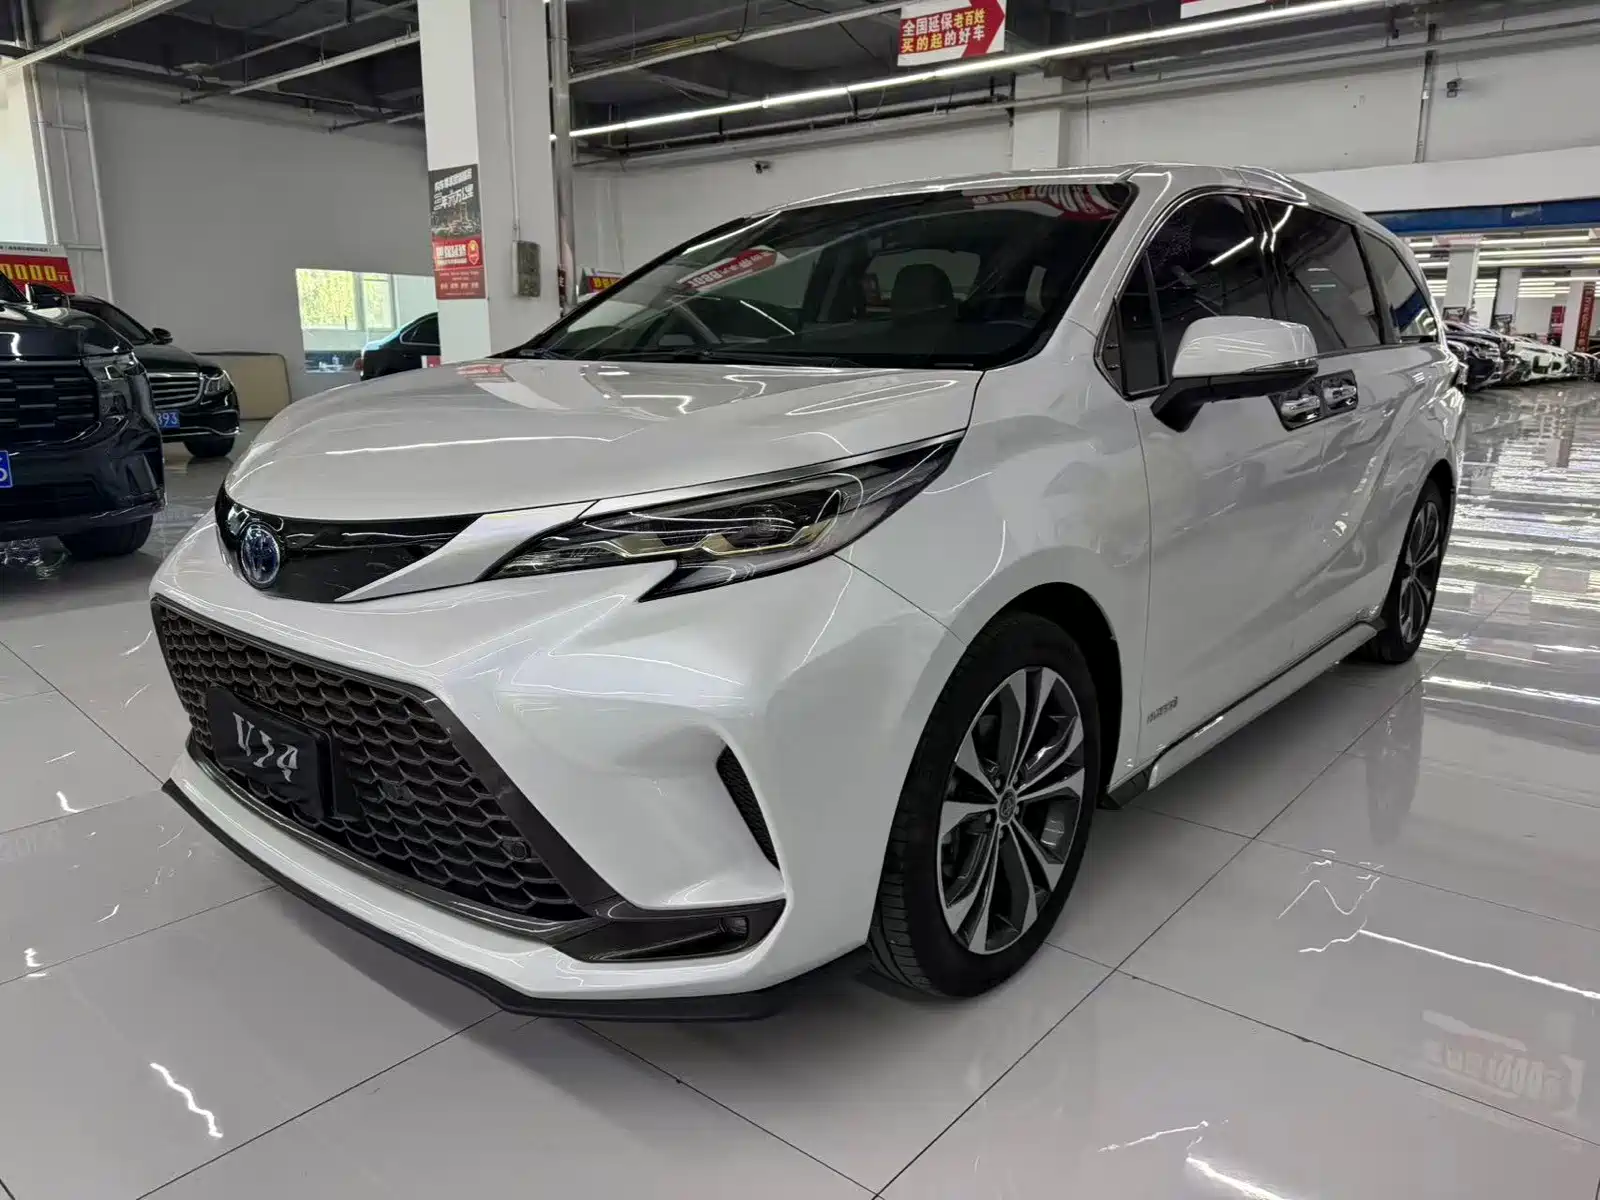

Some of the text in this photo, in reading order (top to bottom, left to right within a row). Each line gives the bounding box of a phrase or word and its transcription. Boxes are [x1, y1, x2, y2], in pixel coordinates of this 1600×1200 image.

[902, 8, 985, 36] 全国延保老百姓
[902, 25, 985, 53] 买的起的好车
